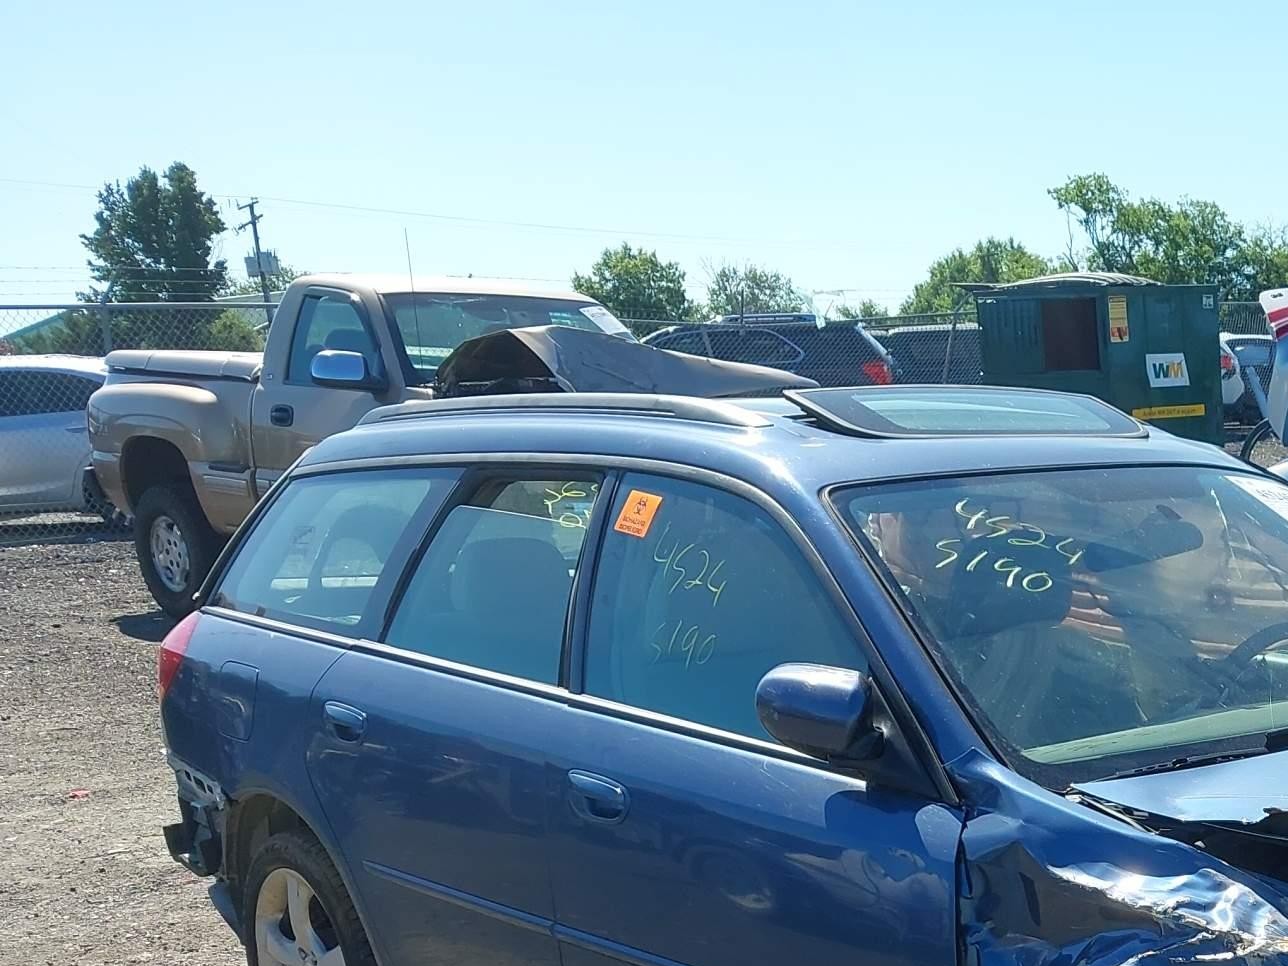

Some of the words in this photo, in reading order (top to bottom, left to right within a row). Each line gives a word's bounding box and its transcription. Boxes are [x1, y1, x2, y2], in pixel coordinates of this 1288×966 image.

[1152, 361, 1186, 379] WM
[955, 497, 1086, 566] 4524
[653, 520, 728, 607] 4524
[935, 538, 1053, 592] 5190
[650, 619, 717, 672] 5190
